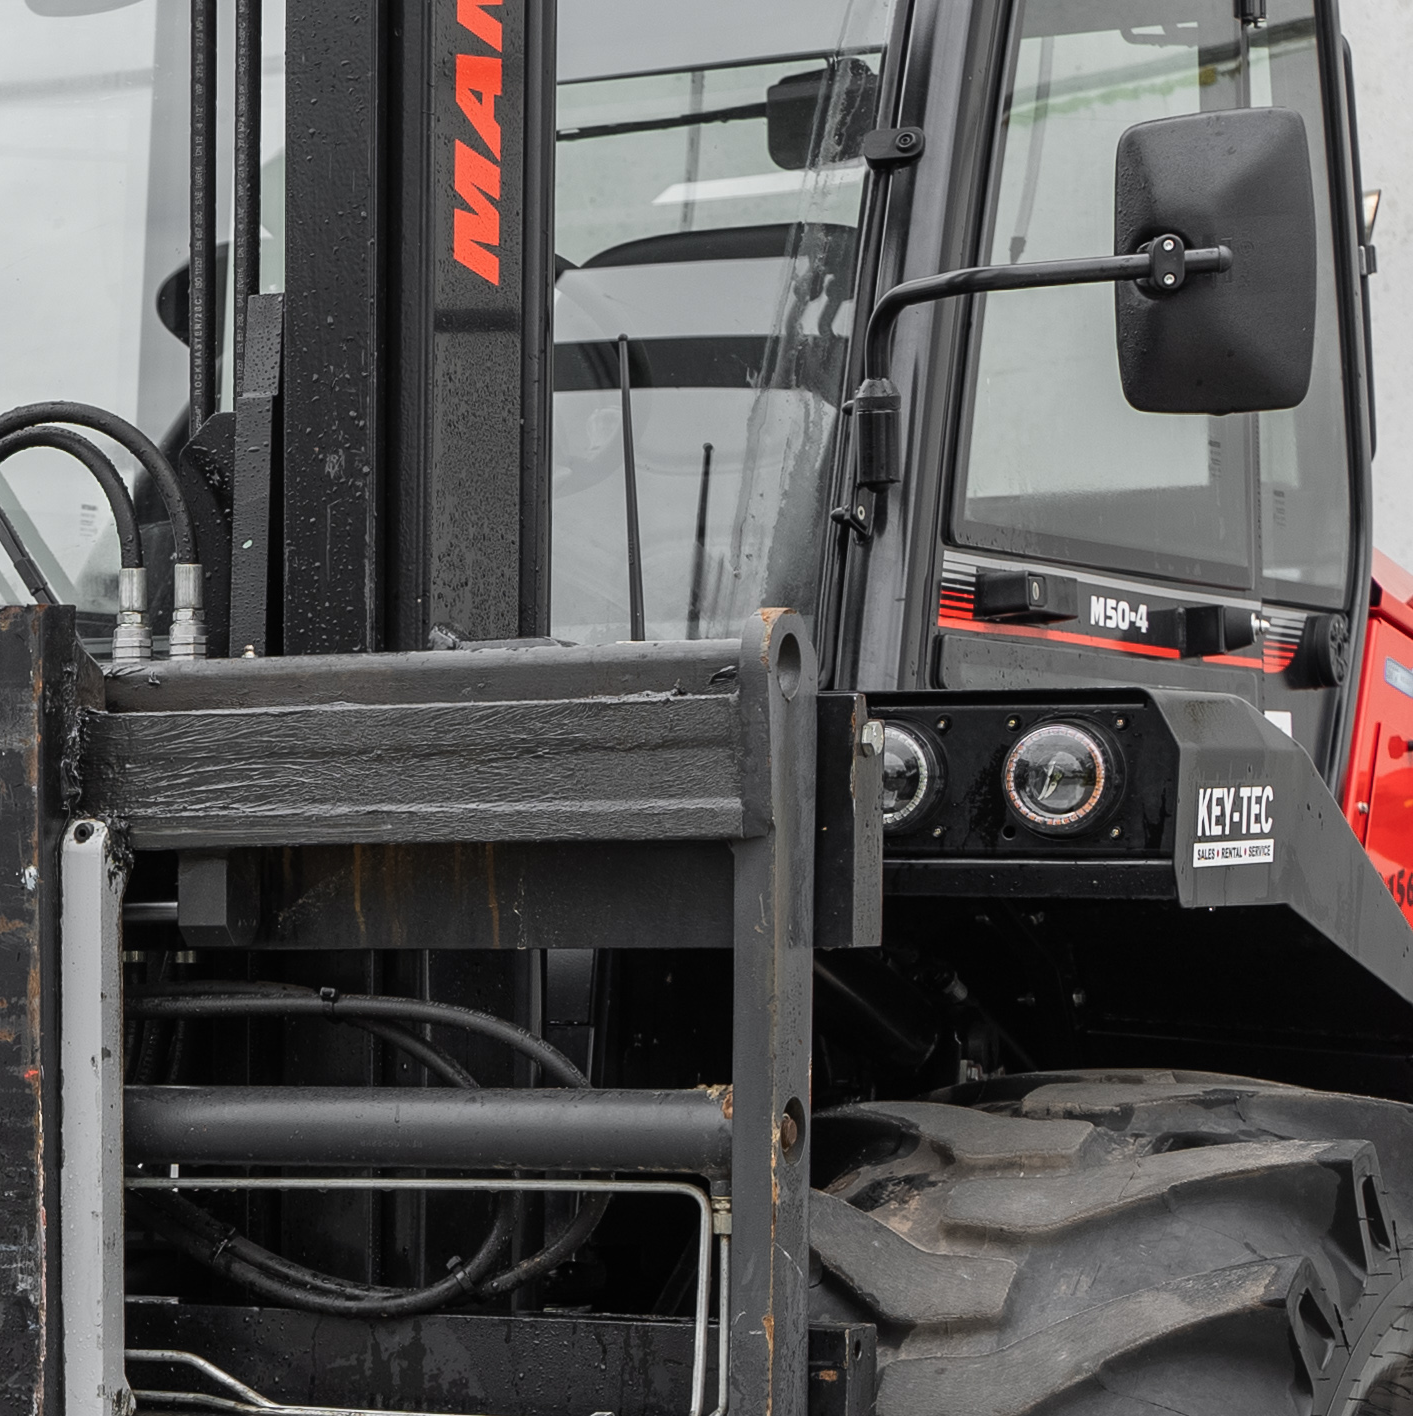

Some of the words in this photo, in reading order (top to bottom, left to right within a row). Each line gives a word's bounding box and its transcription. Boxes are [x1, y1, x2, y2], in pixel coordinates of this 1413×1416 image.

[1196, 785, 1274, 837] KEY-TEC
[1197, 847, 1215, 861] SALES
[1220, 846, 1243, 860] RENTAL
[1248, 844, 1271, 858] SERVICE
